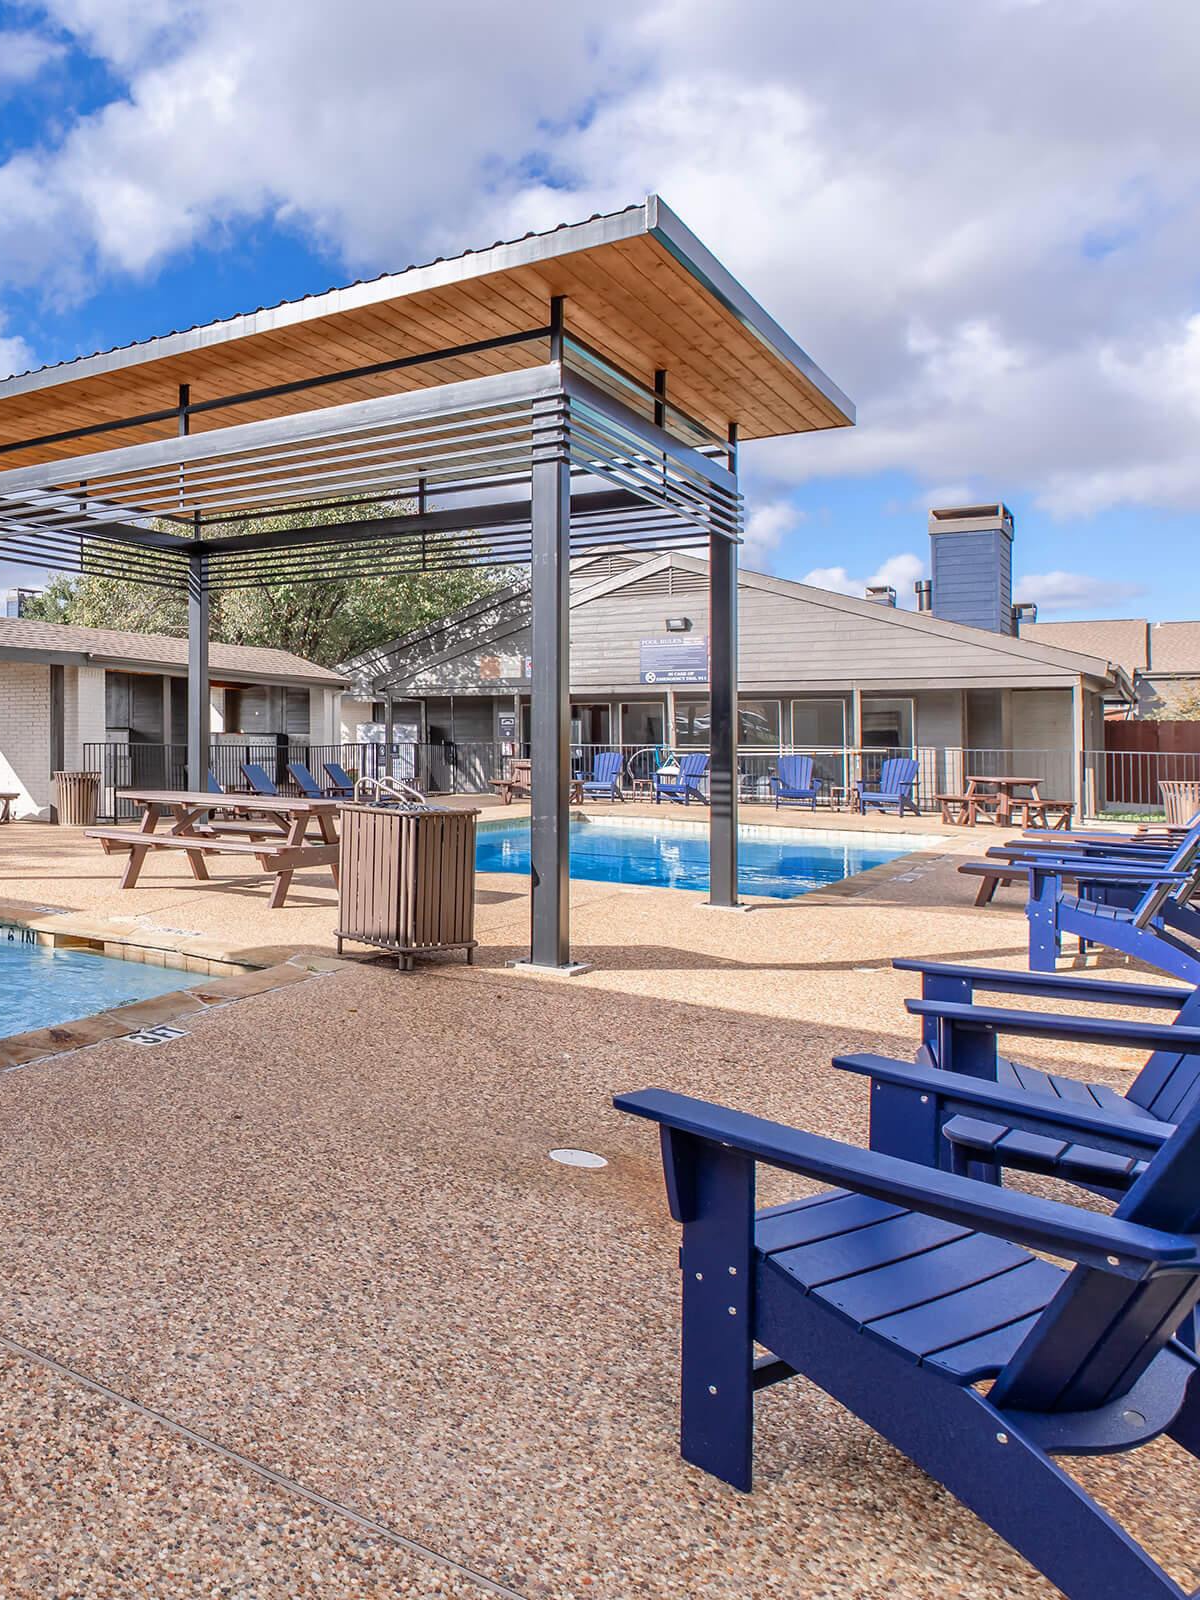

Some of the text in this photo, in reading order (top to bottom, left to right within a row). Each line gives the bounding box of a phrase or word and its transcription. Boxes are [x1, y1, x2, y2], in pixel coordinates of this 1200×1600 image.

[7, 927, 14, 941] 6
[21, 929, 35, 944] IN
[128, 1025, 185, 1044] 3 FT
